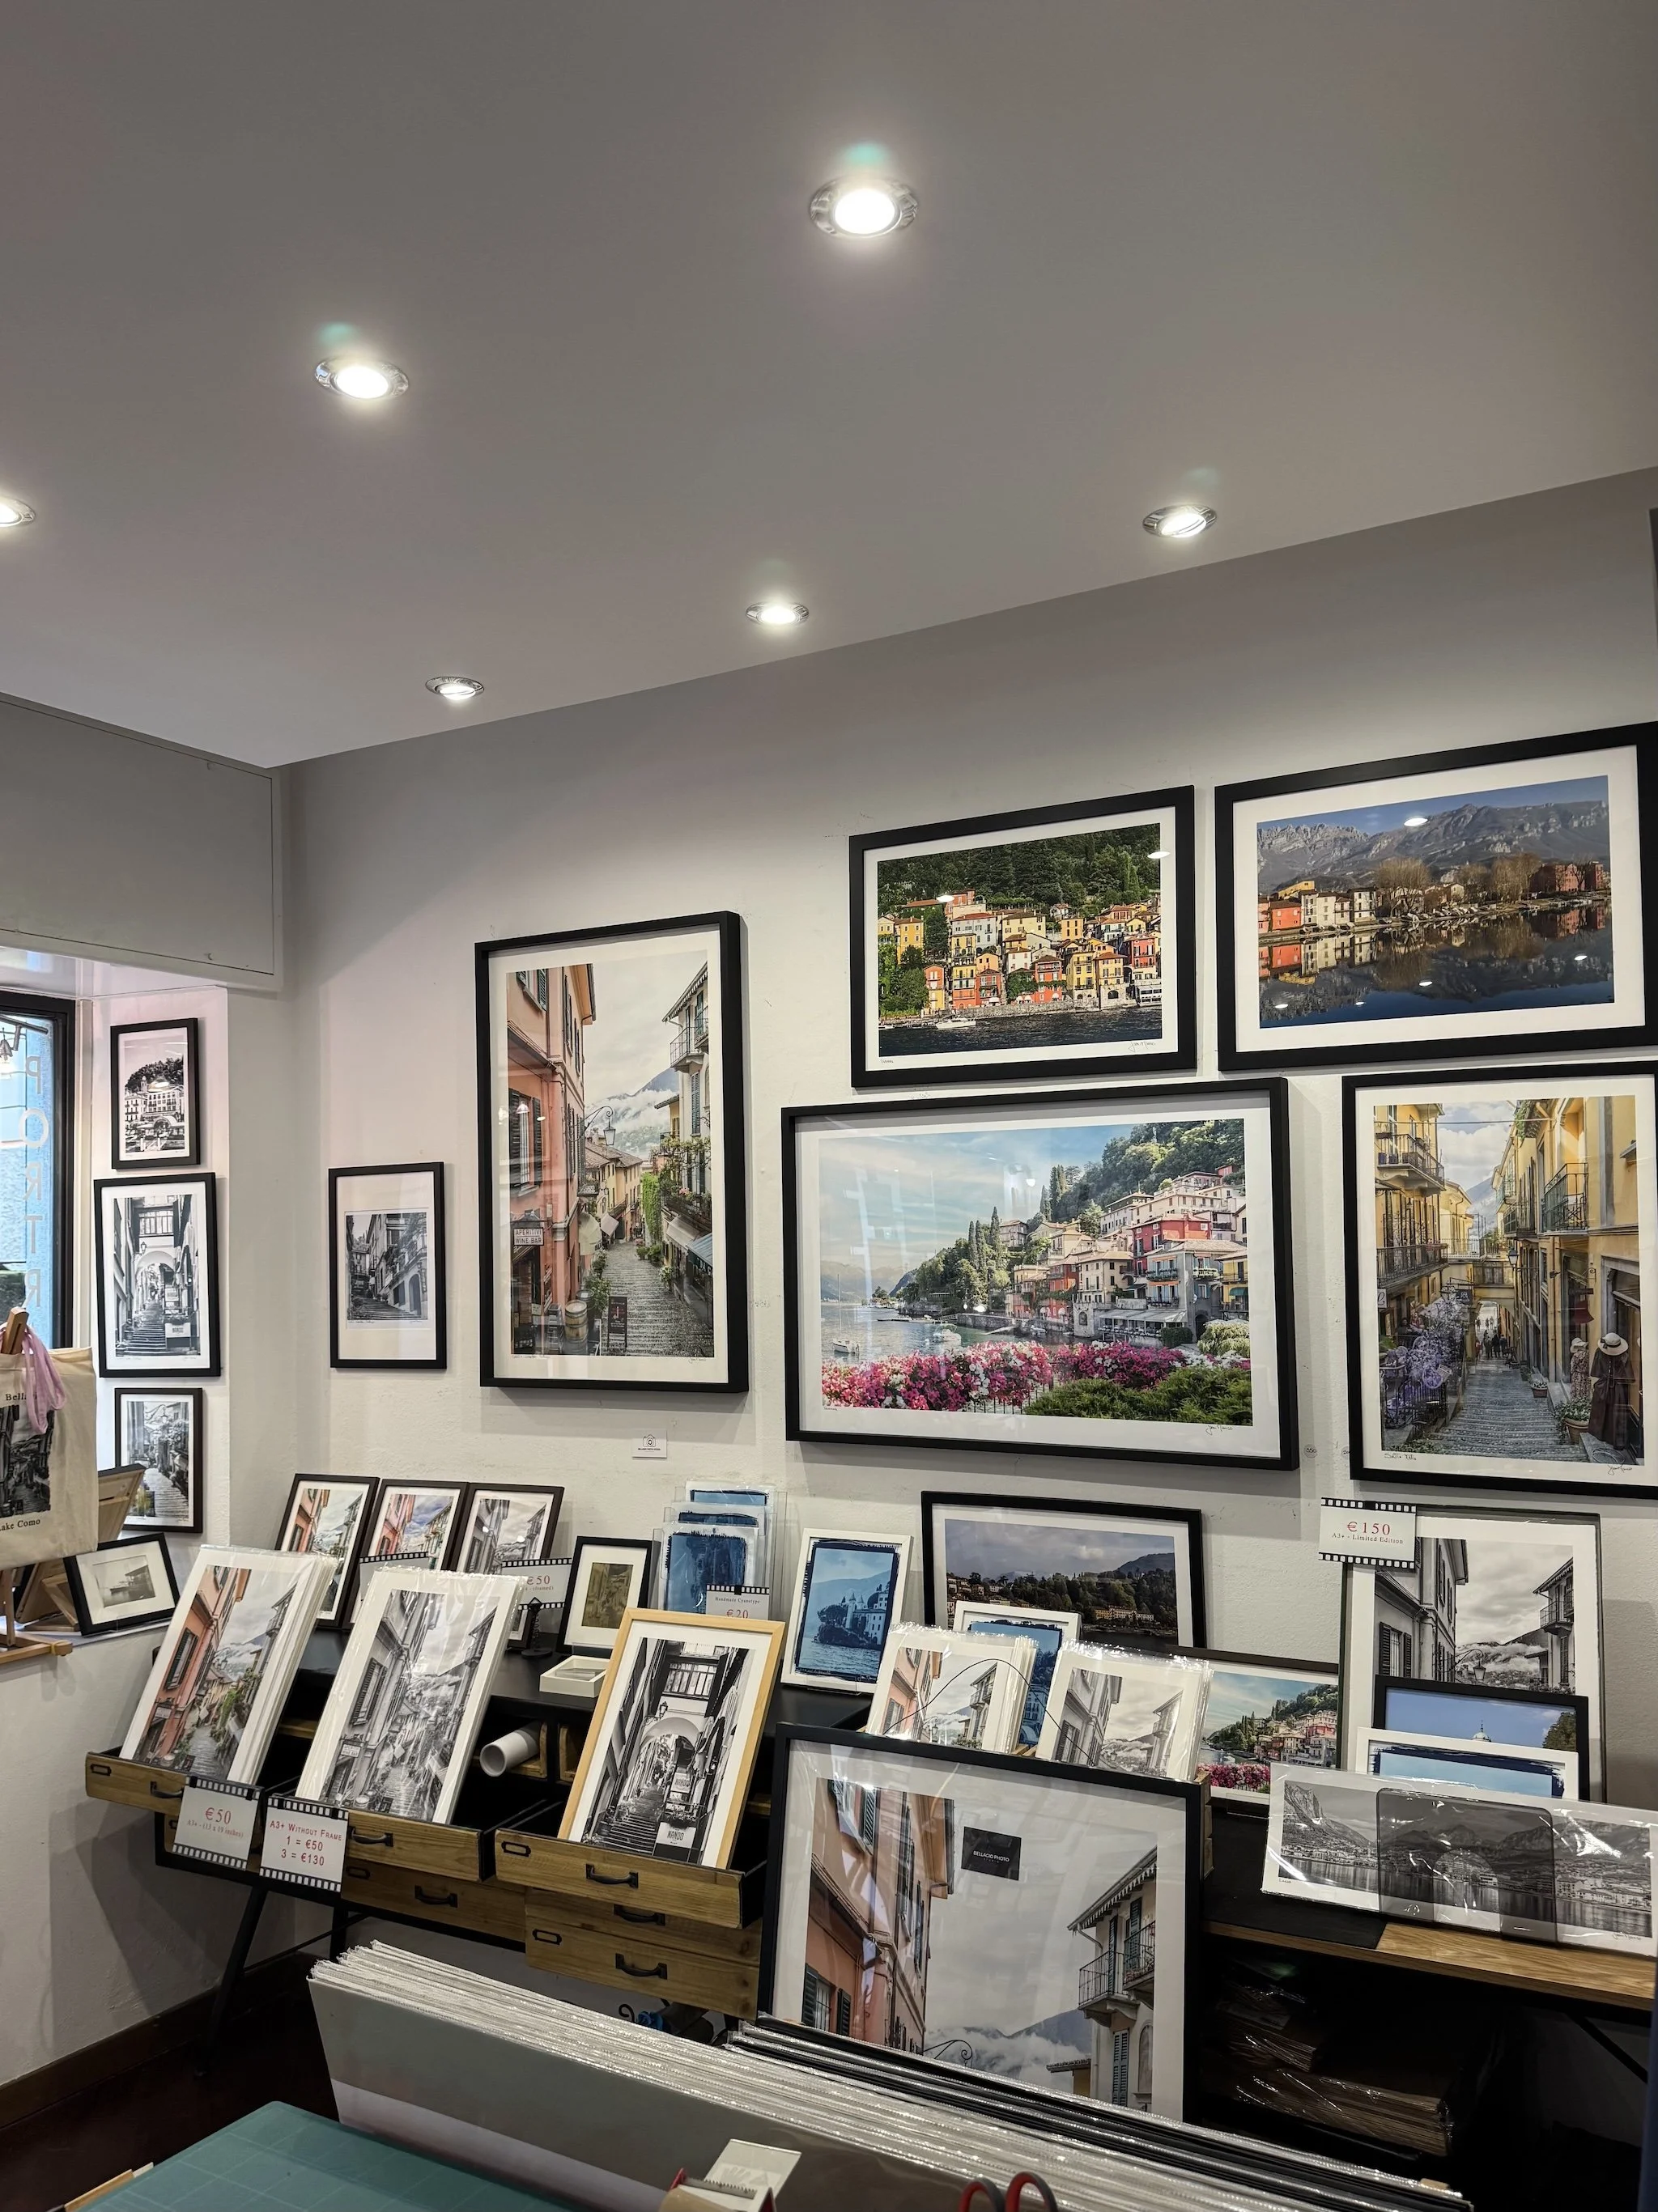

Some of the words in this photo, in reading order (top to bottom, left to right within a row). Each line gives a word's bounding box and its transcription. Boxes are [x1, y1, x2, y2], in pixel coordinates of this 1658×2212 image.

[17, 1519, 40, 1528] Como
[1346, 1521, 1390, 1535] €150
[1352, 1535, 1377, 1543] Limited
[1380, 1536, 1404, 1544] Edition
[526, 1575, 551, 1586] €50
[726, 1609, 749, 1619] €20
[205, 1807, 232, 1825] €50
[270, 1820, 285, 1829] A3+
[667, 1830, 684, 1841] NANDO
[287, 1836, 291, 1845] 1
[305, 1839, 324, 1852] €50
[281, 1849, 287, 1858] 3
[301, 1853, 325, 1866] €130
[973, 1850, 994, 1859] BELLAGIO
[994, 1854, 1010, 1862] PHOTO
